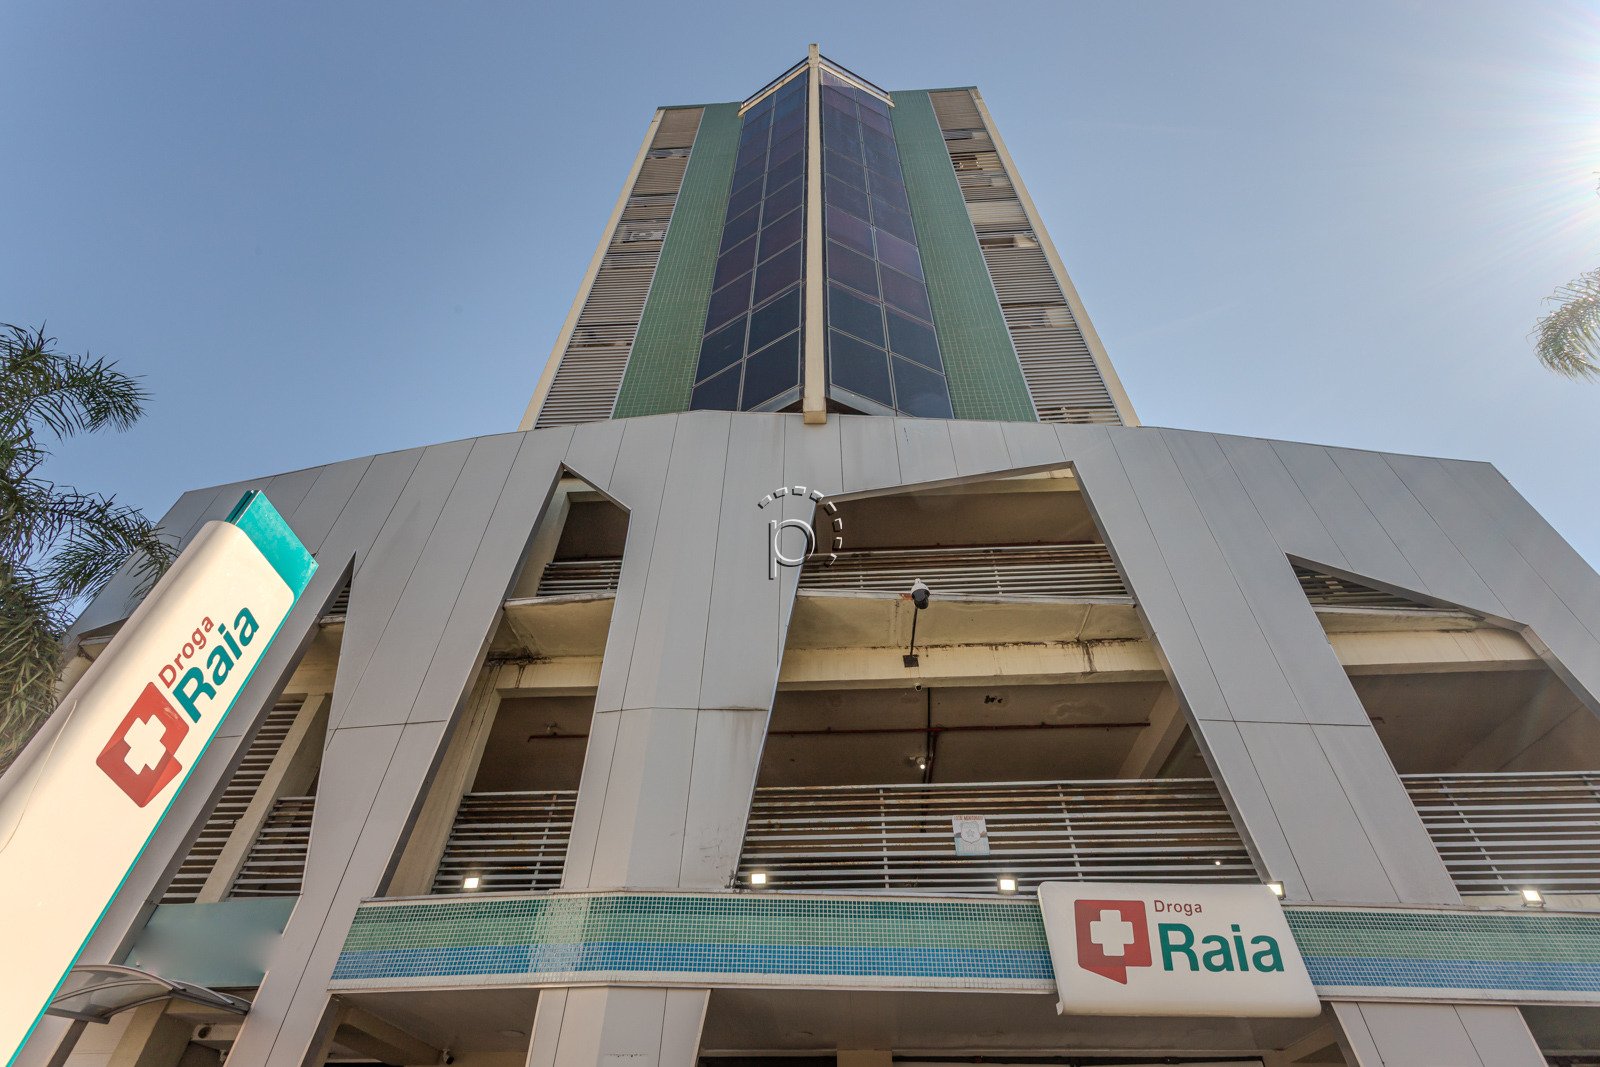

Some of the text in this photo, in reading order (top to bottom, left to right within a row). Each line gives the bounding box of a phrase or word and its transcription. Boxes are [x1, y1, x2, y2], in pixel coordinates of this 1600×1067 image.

[158, 616, 214, 689] Droga
[172, 607, 260, 724] Raia
[1154, 900, 1203, 916] Droga
[1158, 923, 1285, 973] Raia
